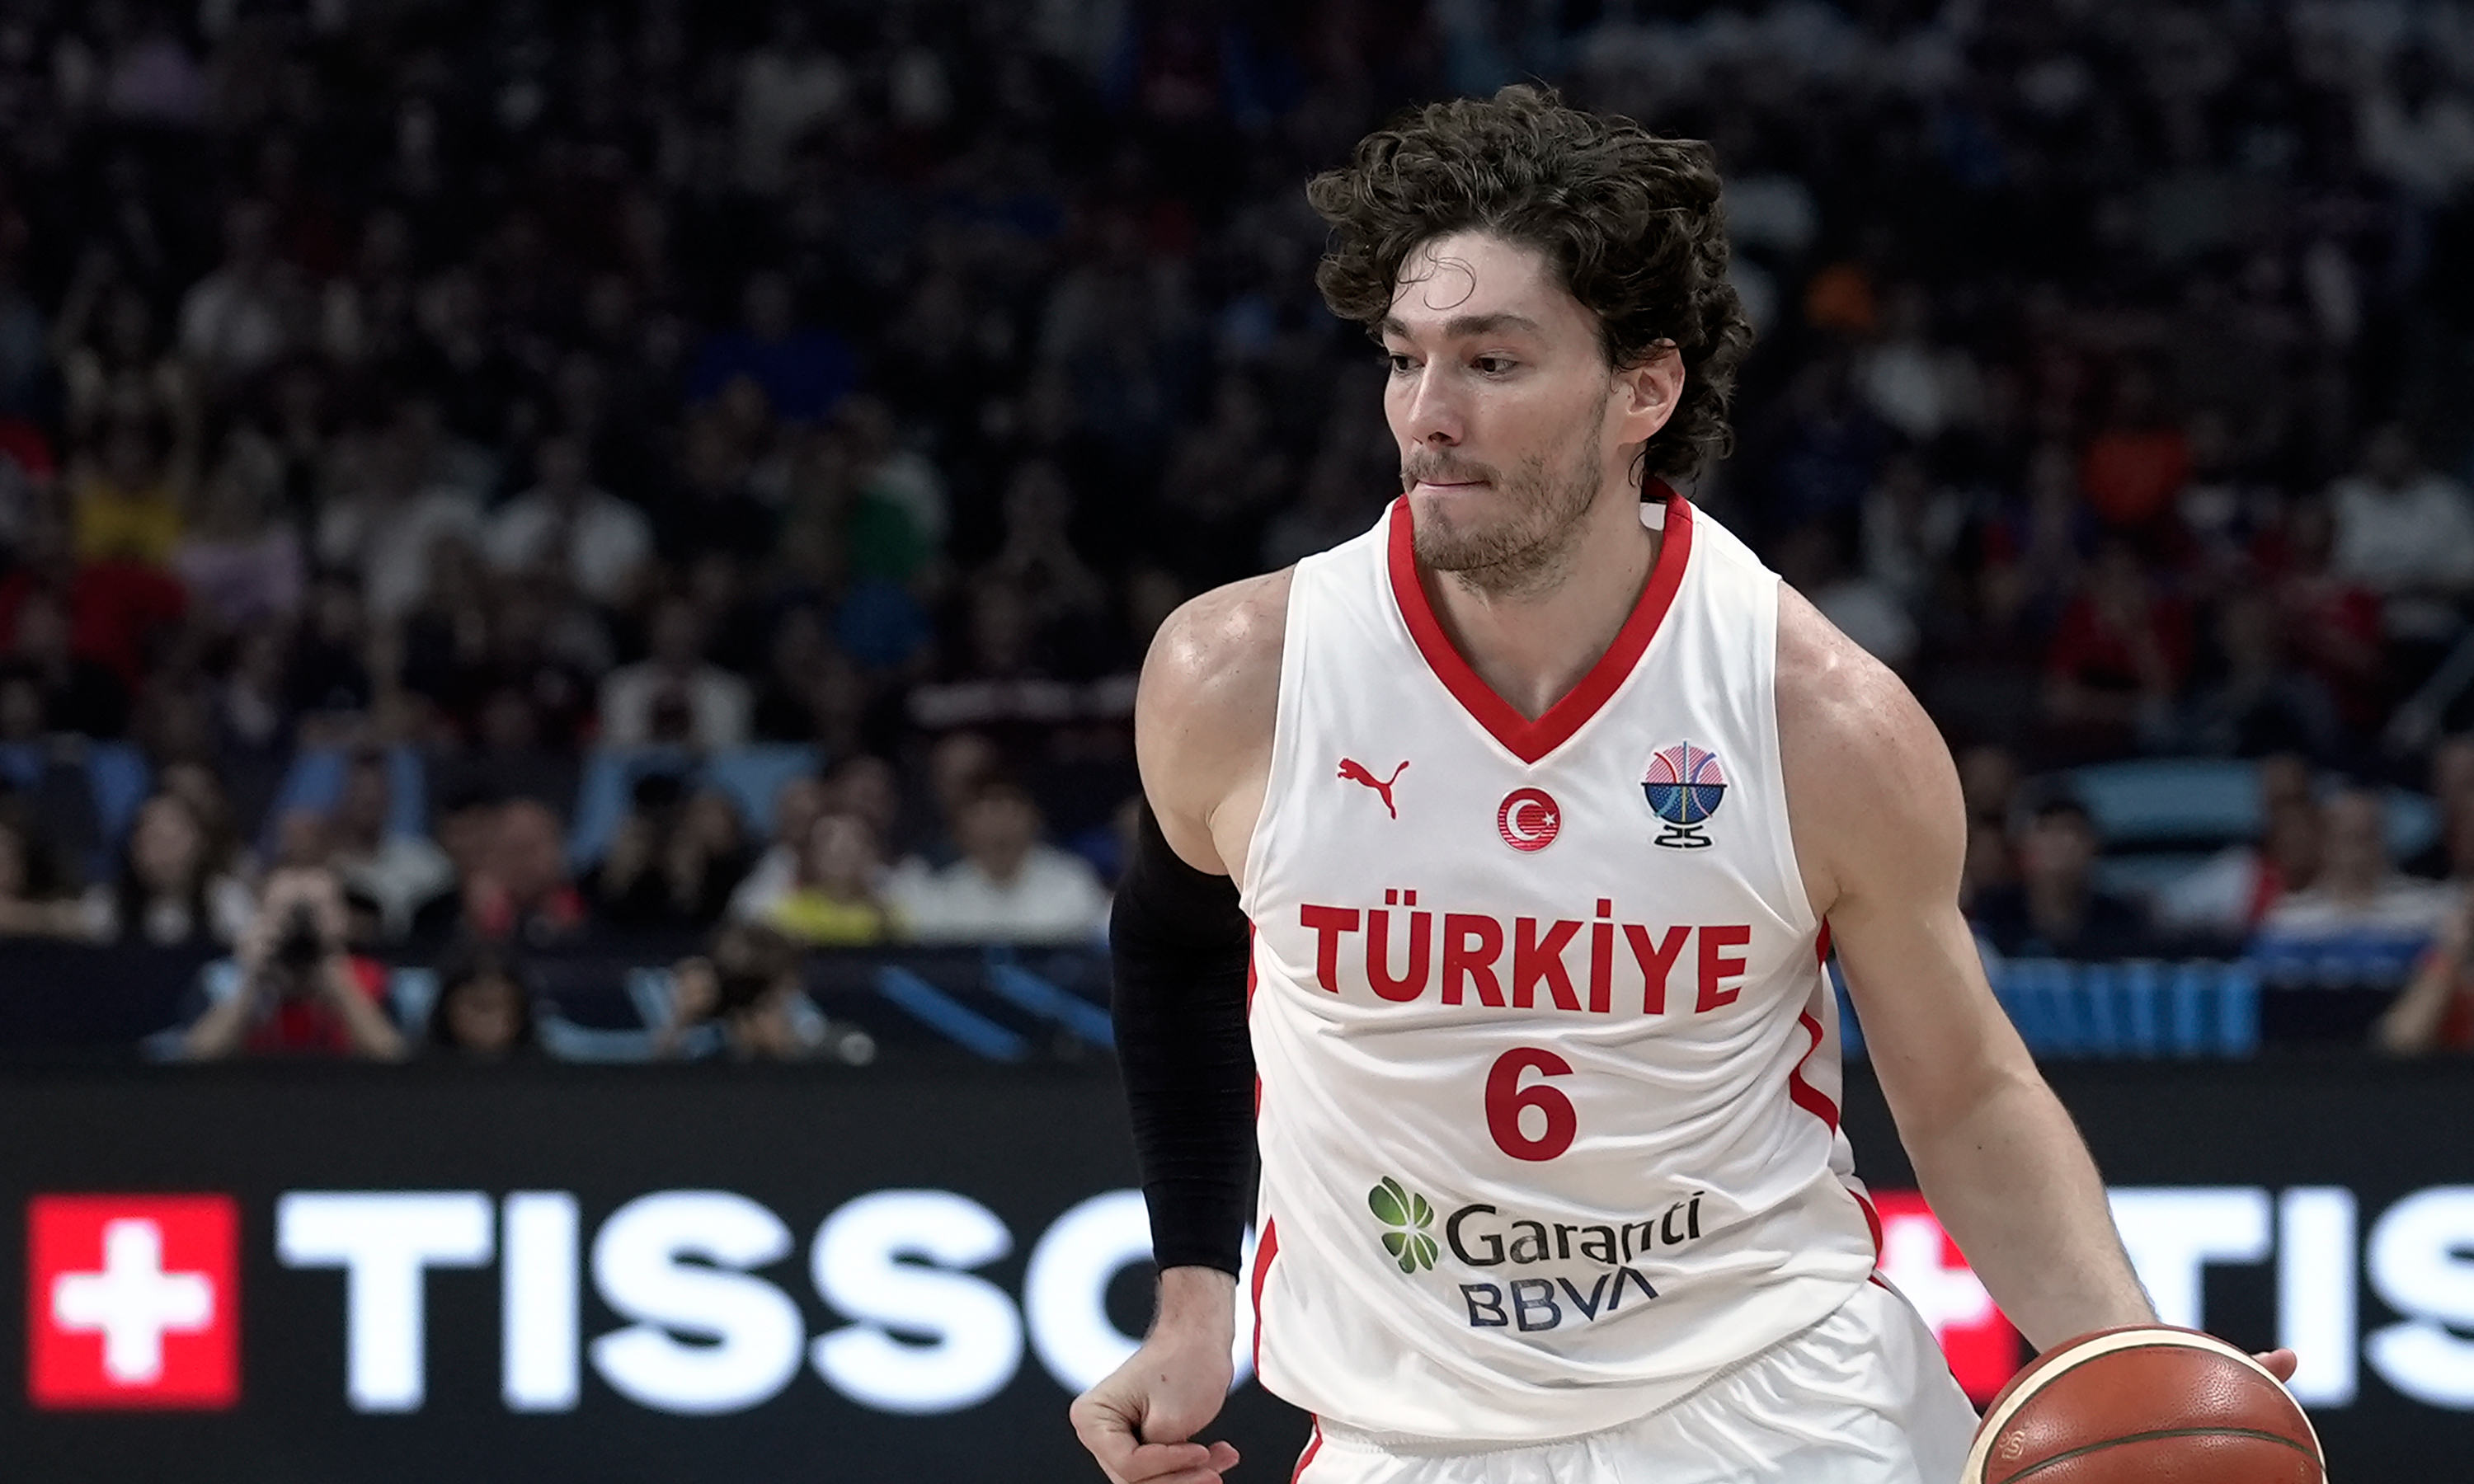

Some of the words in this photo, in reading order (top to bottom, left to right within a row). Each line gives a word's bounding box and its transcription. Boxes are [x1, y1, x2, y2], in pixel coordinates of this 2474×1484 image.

[1300, 889, 1752, 1015] TÜRKİYE
[1485, 1047, 1578, 1162] 6
[1446, 1190, 1705, 1266] Garanti
[1459, 1266, 1659, 1332] BBVA
